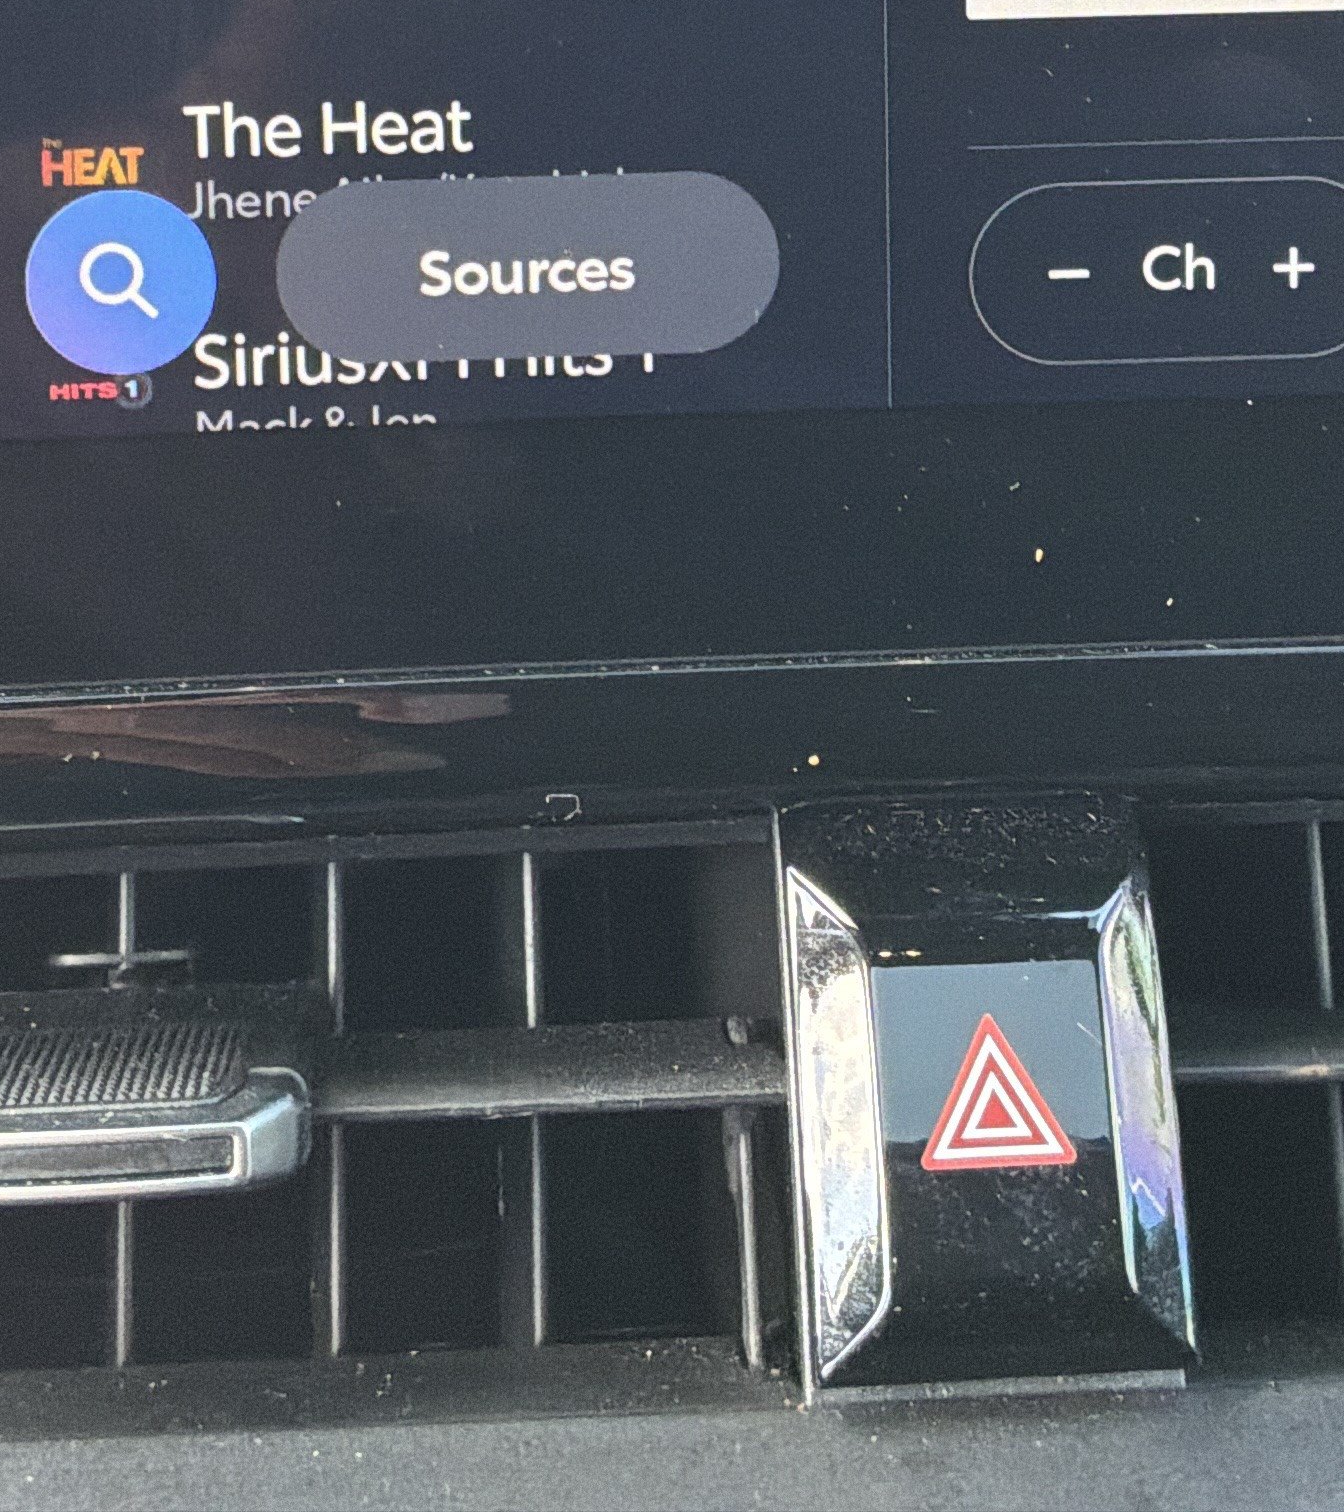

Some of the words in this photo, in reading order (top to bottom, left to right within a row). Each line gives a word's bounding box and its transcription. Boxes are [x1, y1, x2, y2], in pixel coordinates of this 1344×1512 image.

[181, 100, 303, 160] The
[320, 99, 475, 156] Heat
[41, 146, 145, 187] HEAT
[419, 249, 637, 298] Sources
[1141, 241, 1217, 292] Ch
[49, 380, 119, 401] HITS
